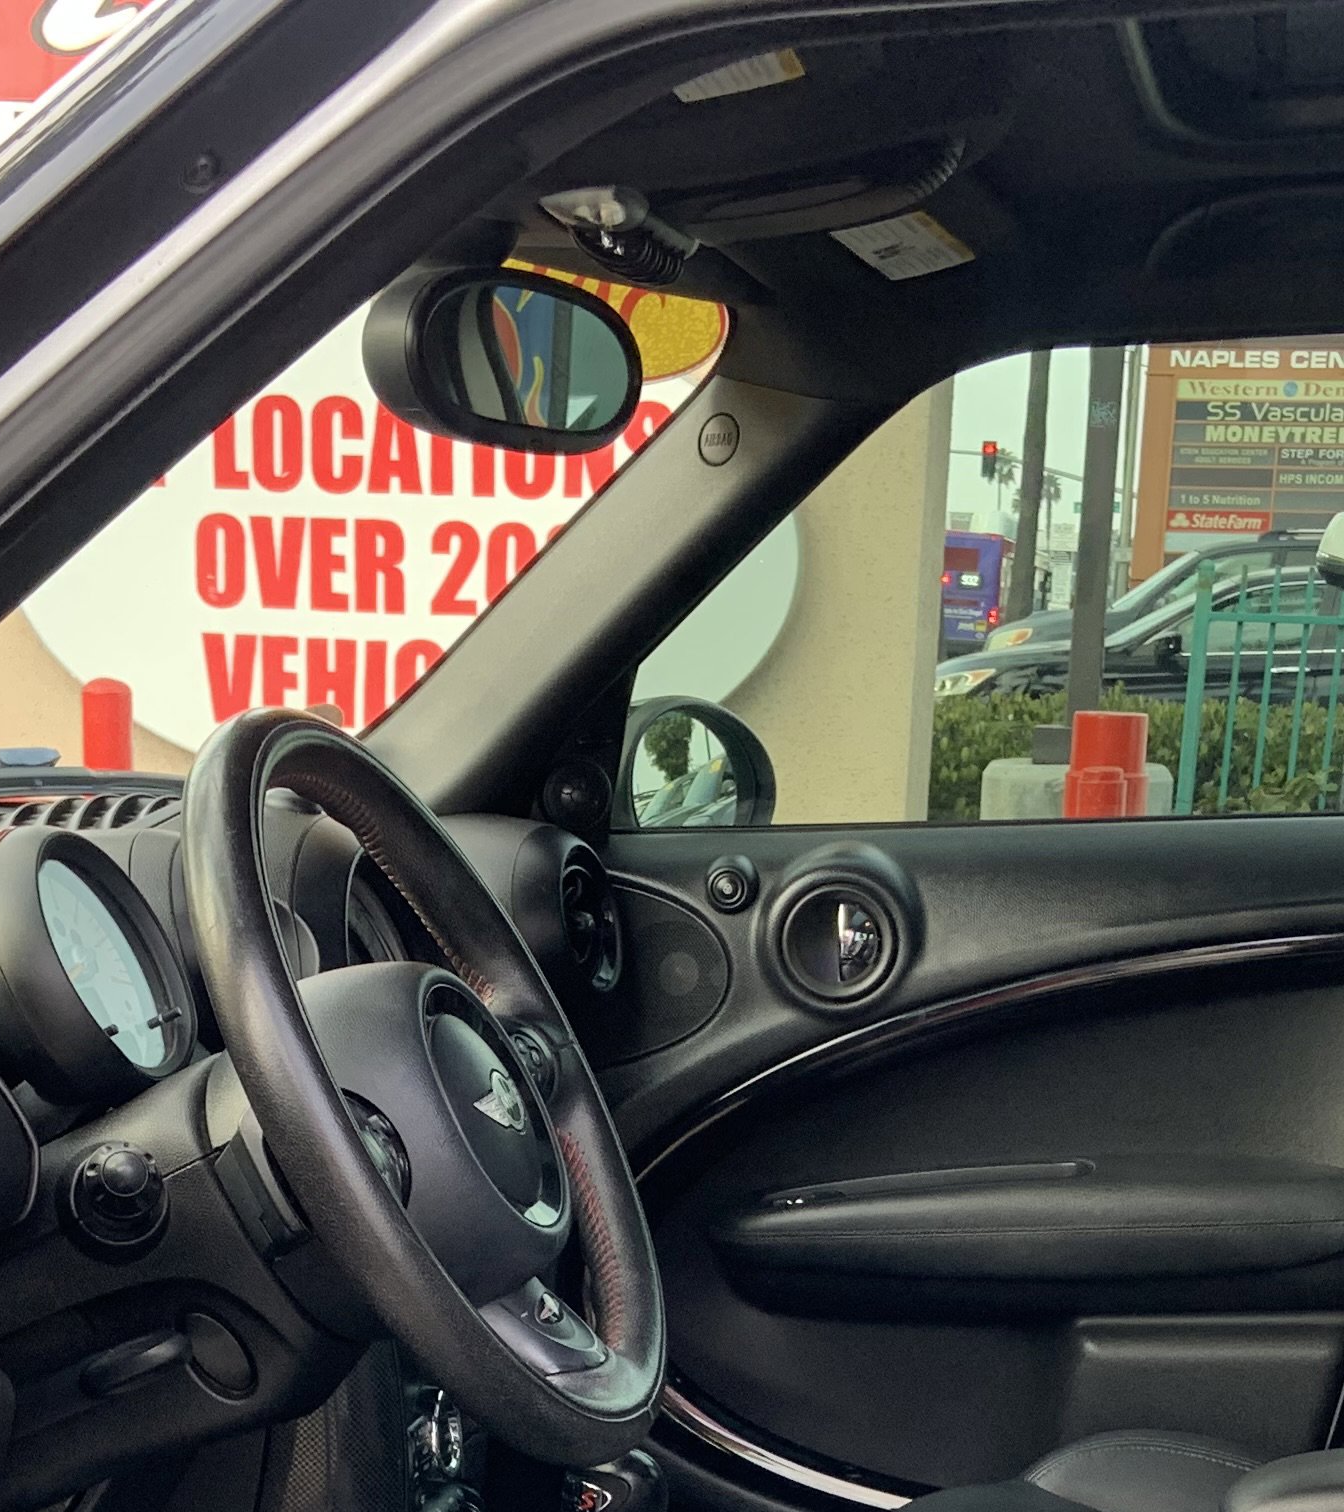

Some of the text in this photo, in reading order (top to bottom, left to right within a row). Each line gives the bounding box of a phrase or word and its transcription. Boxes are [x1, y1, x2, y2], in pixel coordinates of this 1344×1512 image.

[1169, 350, 1281, 369] NAPLES
[1188, 380, 1278, 397] Western
[1206, 401, 1242, 421] SS
[1280, 448, 1314, 459] STEP
[1188, 494, 1201, 505] to
[1211, 494, 1261, 506] Nutrition
[195, 512, 405, 615] OVER
